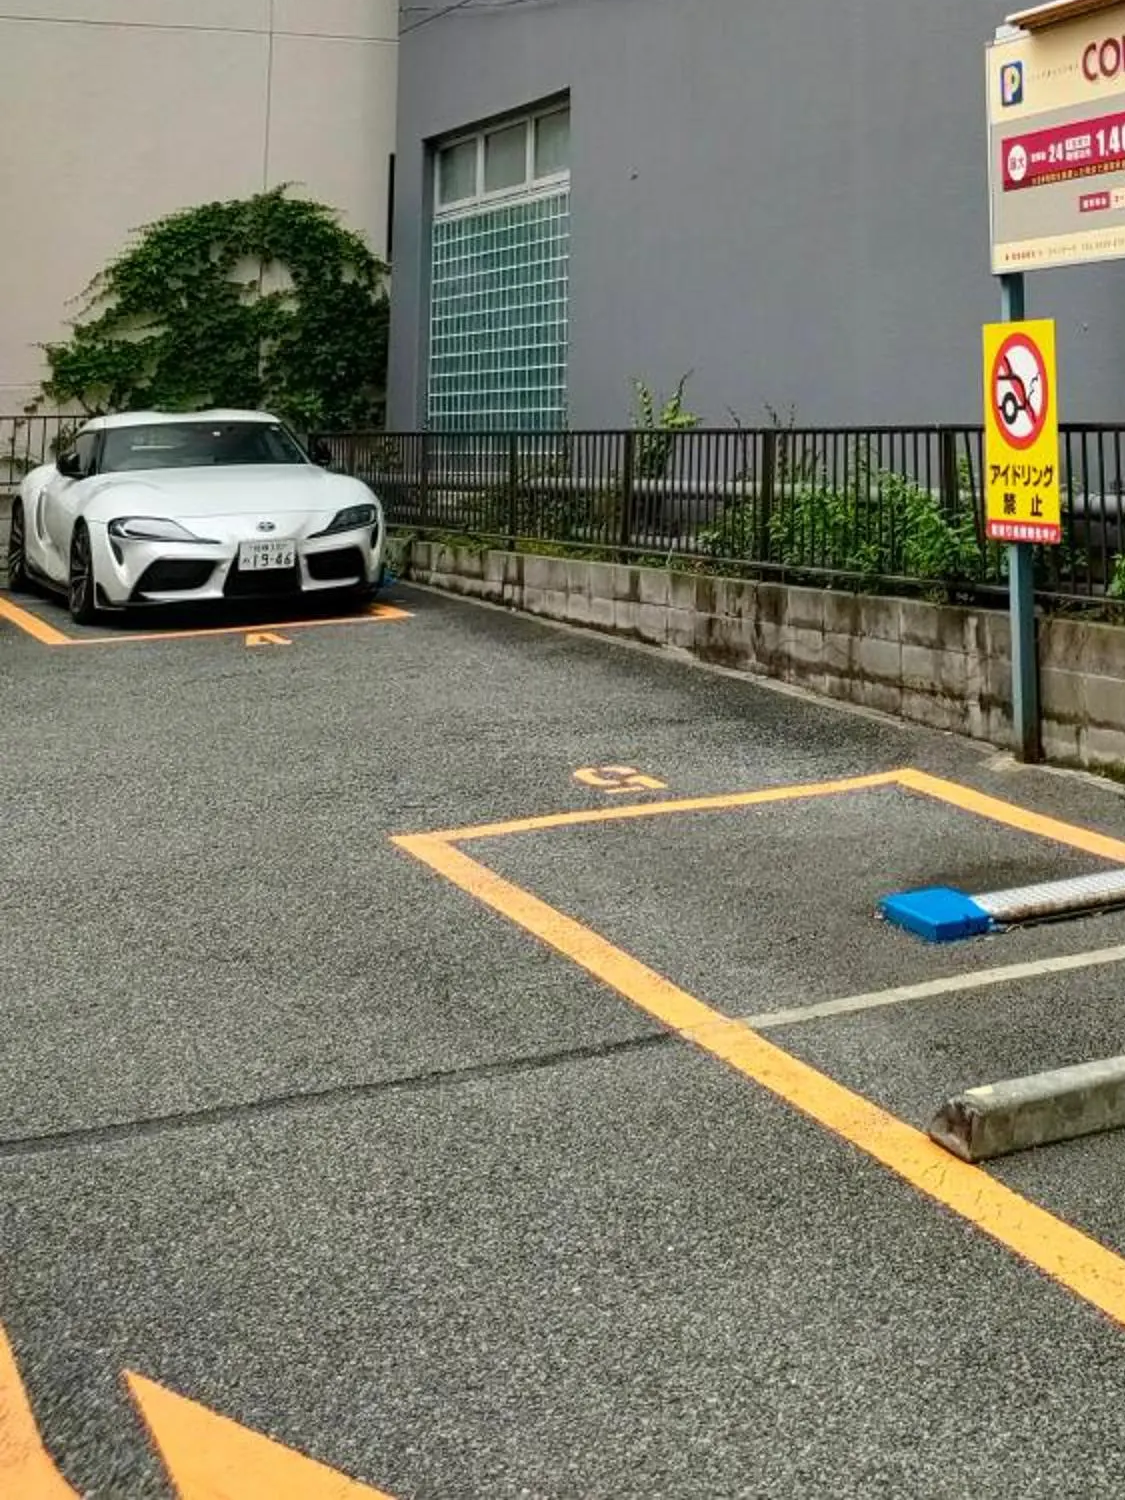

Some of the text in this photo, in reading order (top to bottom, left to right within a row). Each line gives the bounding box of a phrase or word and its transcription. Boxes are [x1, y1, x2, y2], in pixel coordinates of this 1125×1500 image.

[990, 463, 1054, 488] アイドリング
